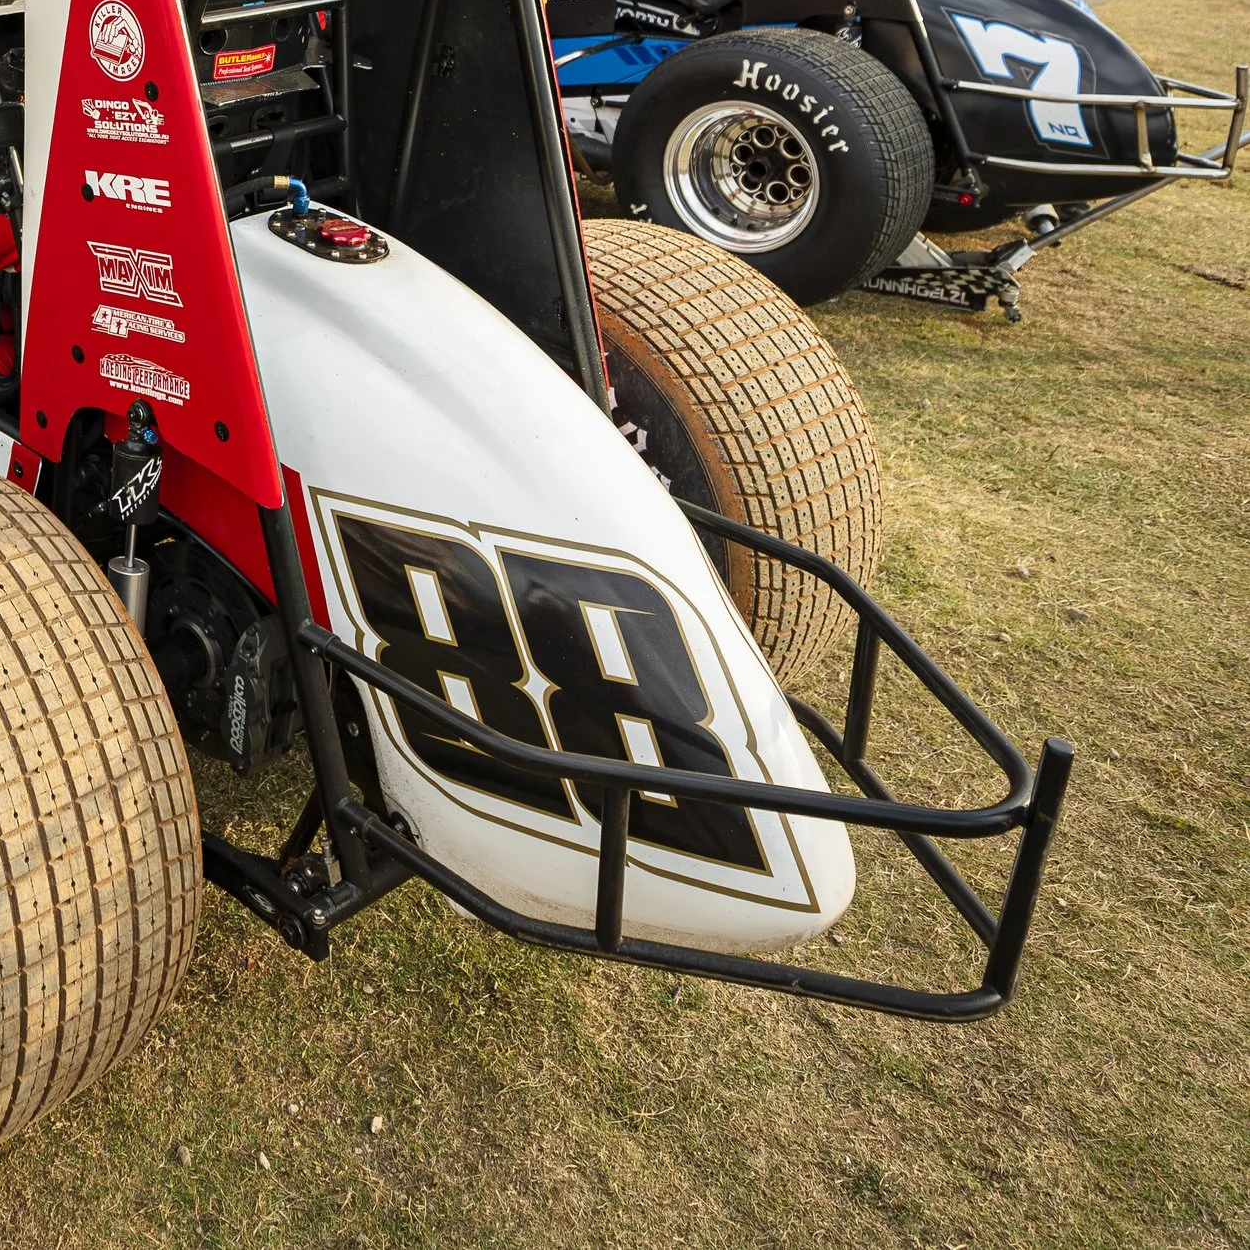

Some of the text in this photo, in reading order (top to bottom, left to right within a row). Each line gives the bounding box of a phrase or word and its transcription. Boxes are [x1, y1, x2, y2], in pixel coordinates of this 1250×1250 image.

[94, 5, 124, 29] KILLER
[952, 14, 1093, 148] 7
[94, 99, 130, 111] DINGO
[114, 111, 138, 122] EZY
[733, 59, 850, 152] Hoosier
[94, 120, 159, 134] SOLUTIONS
[85, 170, 172, 207] KRE
[125, 203, 163, 213] ENGINES
[87, 241, 183, 307] MAXIM
[150, 327, 184, 341] SERVICES
[100, 358, 190, 397] KAEDING PERFORMANCE
[109, 379, 184, 407] www.kaedings.com
[332, 510, 774, 878] 88
